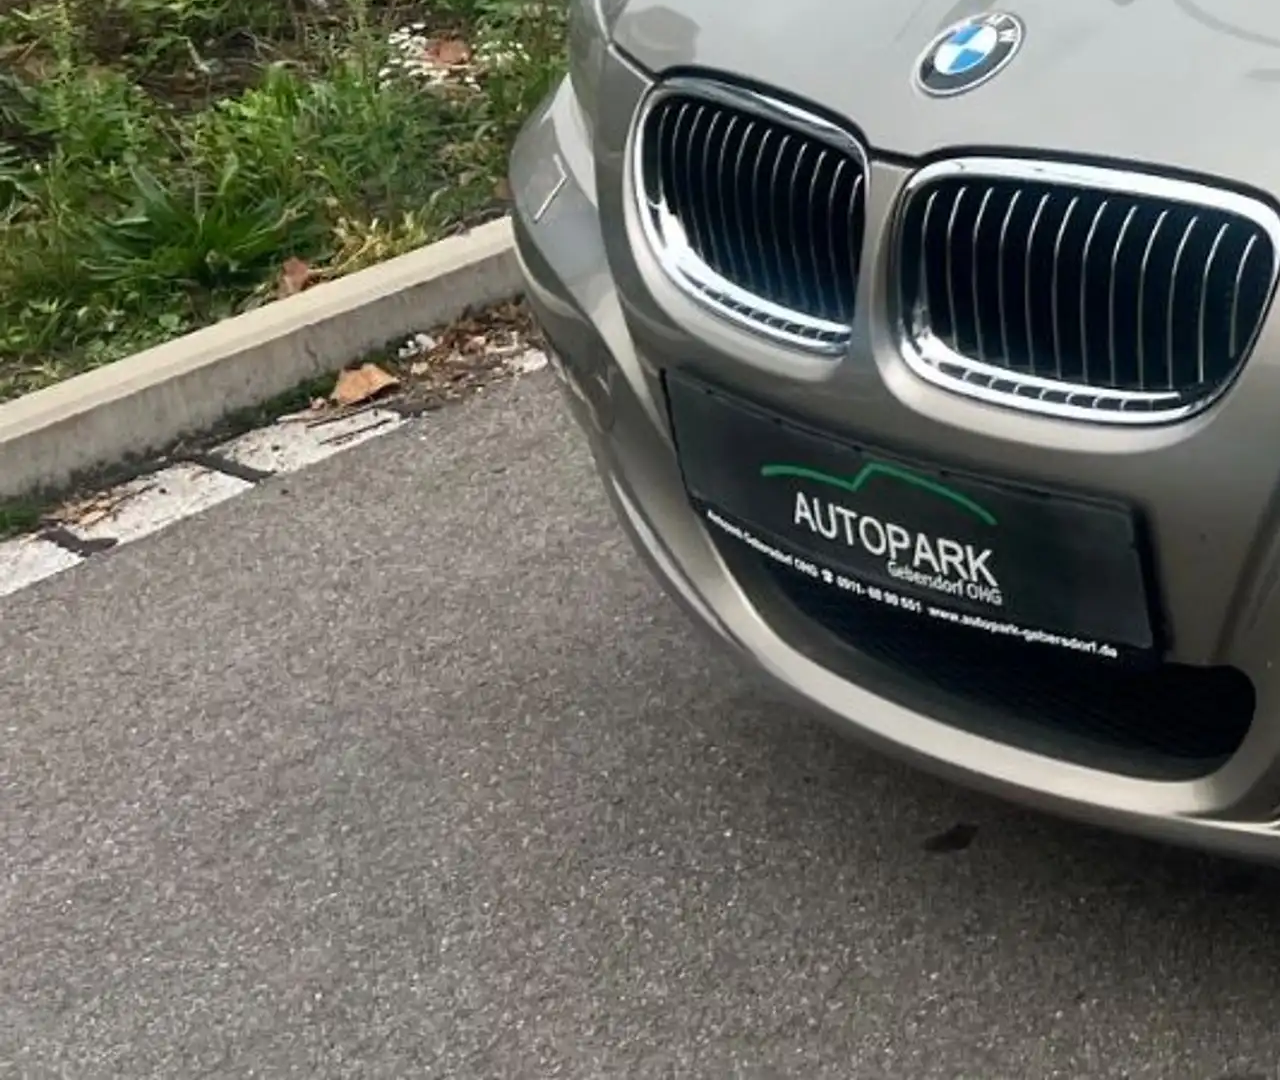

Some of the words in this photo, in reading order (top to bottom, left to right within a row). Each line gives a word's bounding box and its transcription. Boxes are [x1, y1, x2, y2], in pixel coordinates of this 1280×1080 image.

[794, 491, 999, 587] AUTOPARK
[794, 557, 820, 578] OHG
[887, 561, 965, 597] Gebersdorf
[966, 582, 1003, 606] OHG
